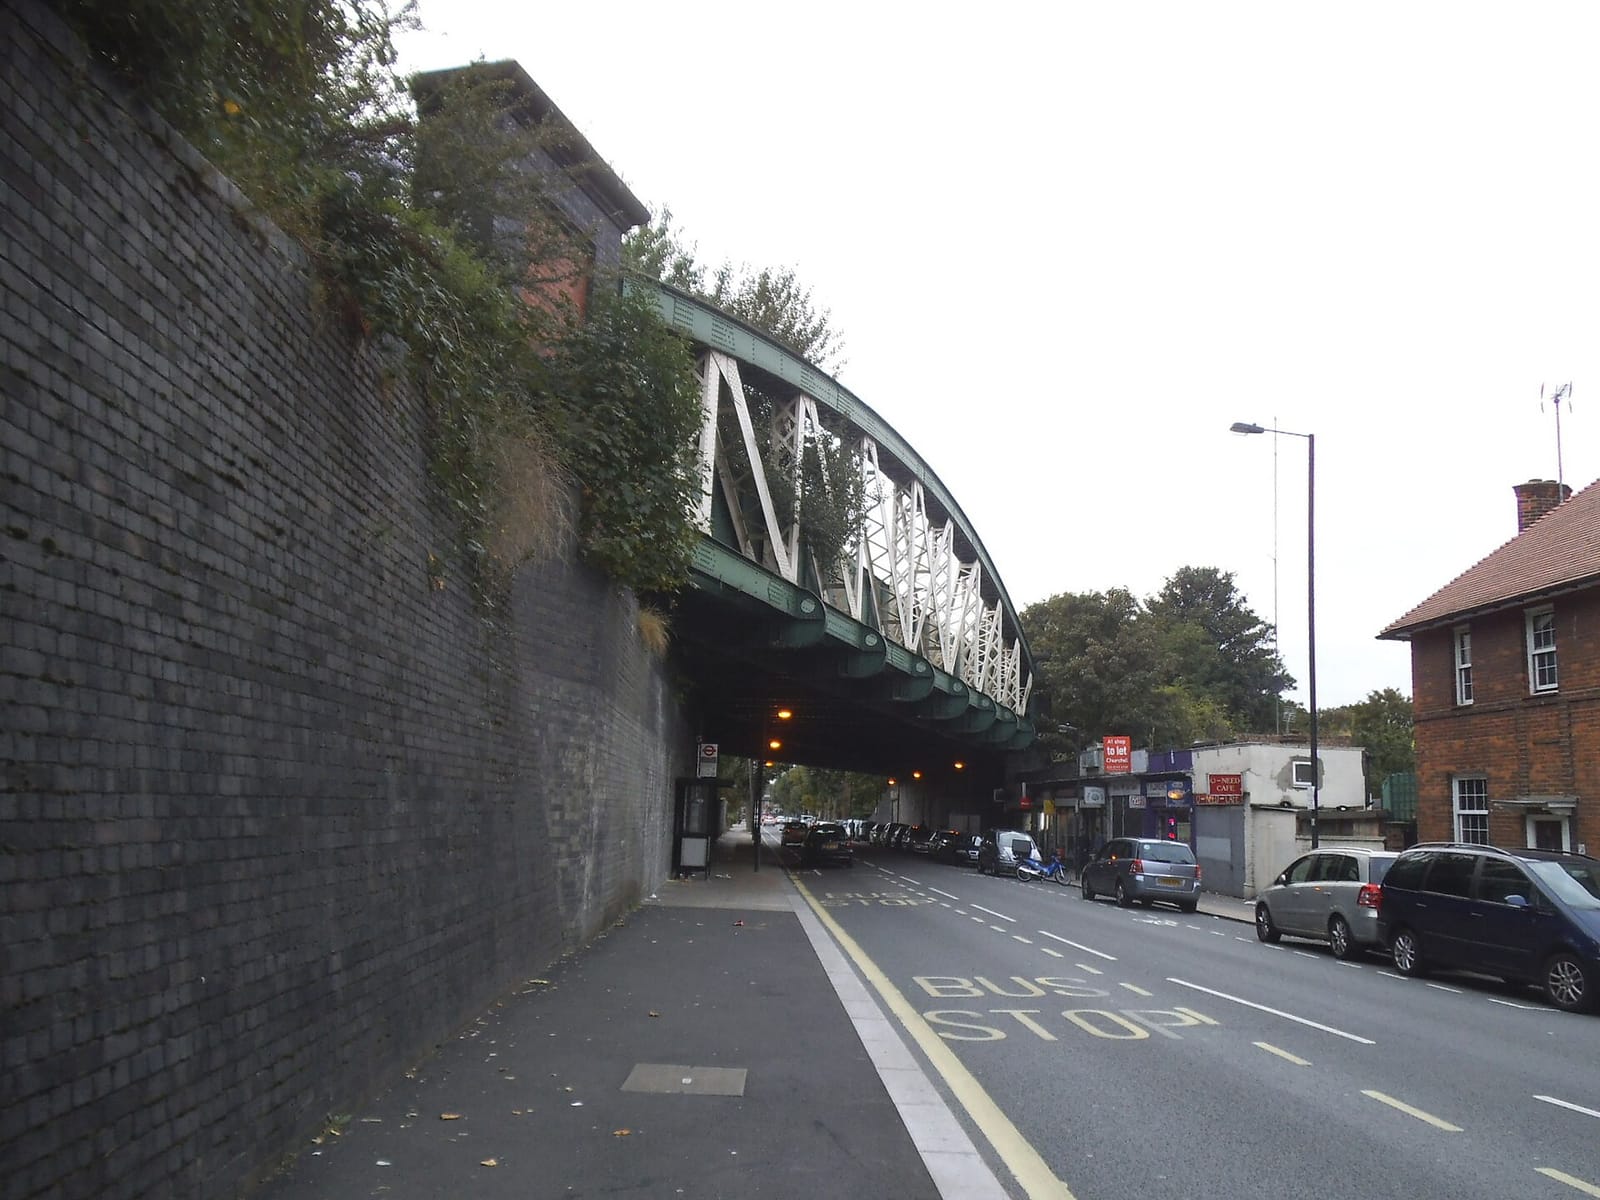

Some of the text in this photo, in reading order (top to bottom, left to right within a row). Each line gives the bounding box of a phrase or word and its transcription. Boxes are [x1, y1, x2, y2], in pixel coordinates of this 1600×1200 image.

[1106, 745, 1128, 755] to let
[911, 976, 1111, 998] BUS
[922, 1008, 1201, 1041] STOP
